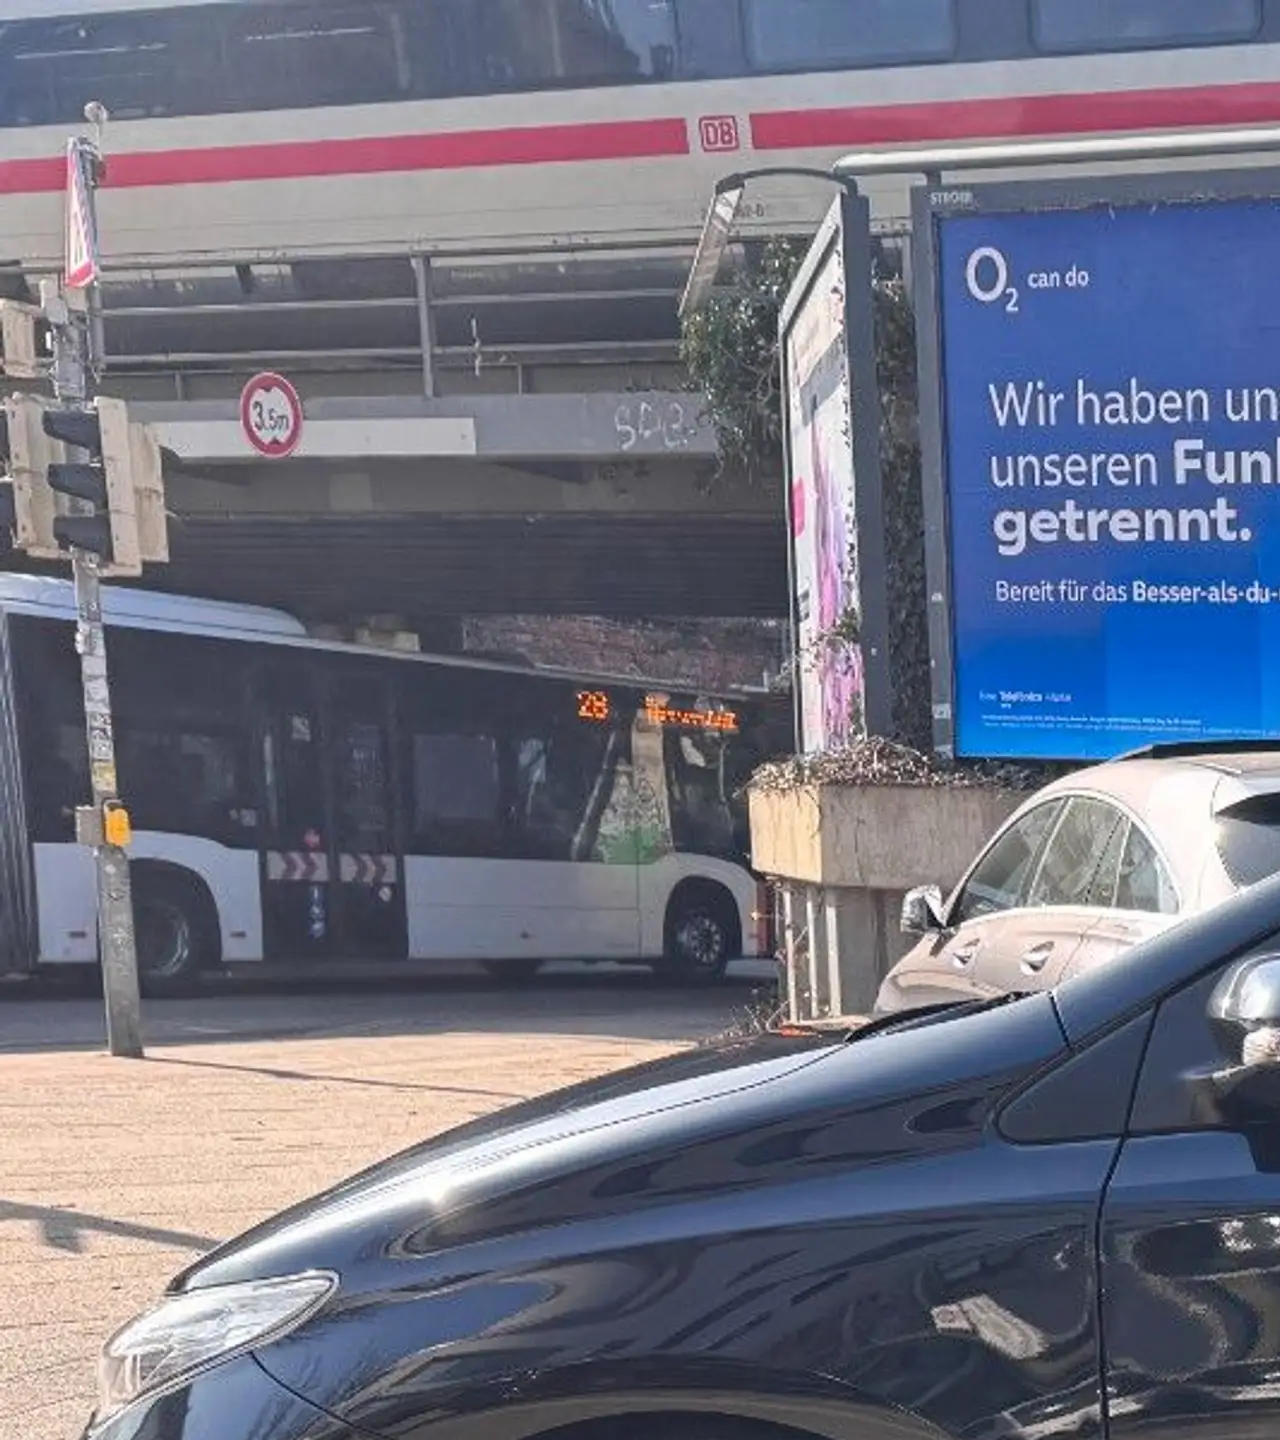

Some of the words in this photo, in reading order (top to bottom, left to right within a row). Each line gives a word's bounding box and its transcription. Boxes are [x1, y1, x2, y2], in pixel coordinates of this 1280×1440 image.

[1027, 271, 1060, 288] can
[1065, 263, 1089, 287] do
[988, 380, 1064, 427] Wir
[1077, 377, 1209, 426] haben
[990, 452, 1158, 487] unseren
[993, 497, 1252, 556] getrennt.
[995, 580, 1051, 602] Bereit
[1059, 579, 1088, 602] für
[1092, 580, 1127, 602] das
[577, 691, 609, 718] 28
